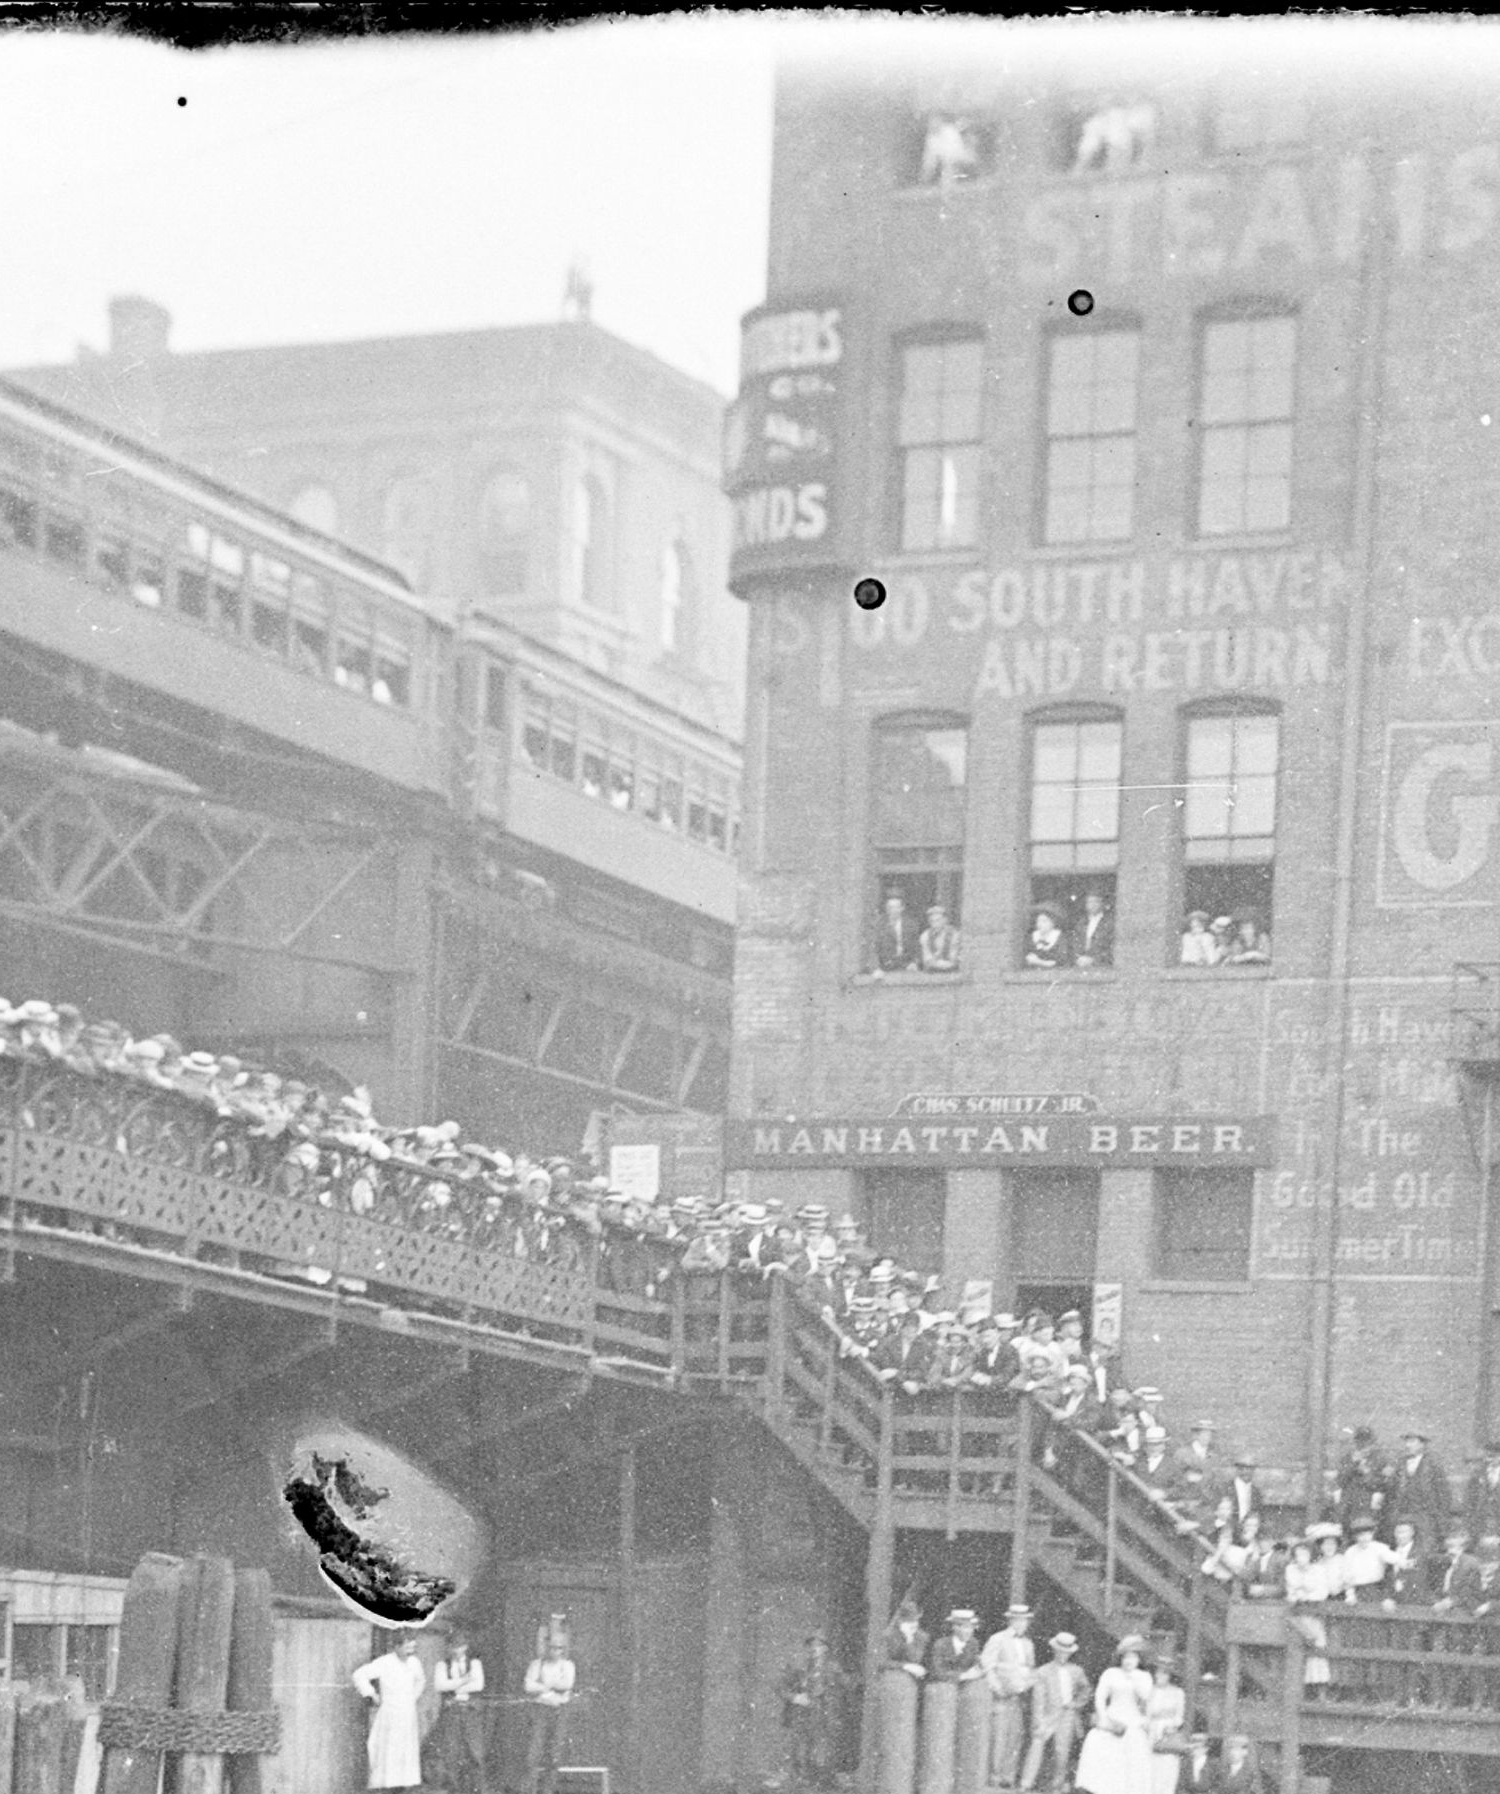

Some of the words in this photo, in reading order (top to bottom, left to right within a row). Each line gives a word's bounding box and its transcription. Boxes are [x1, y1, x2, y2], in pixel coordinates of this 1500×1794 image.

[948, 560, 1144, 633] SOUTH
[975, 636, 1081, 700] AND
[1102, 621, 1330, 693] RETURN
[1396, 738, 1498, 889] G
[753, 1125, 1049, 1154] MANHATTAN
[1089, 1123, 1257, 1154] BEER.
[1358, 1117, 1423, 1157] The
[1392, 1170, 1456, 1210] Old
